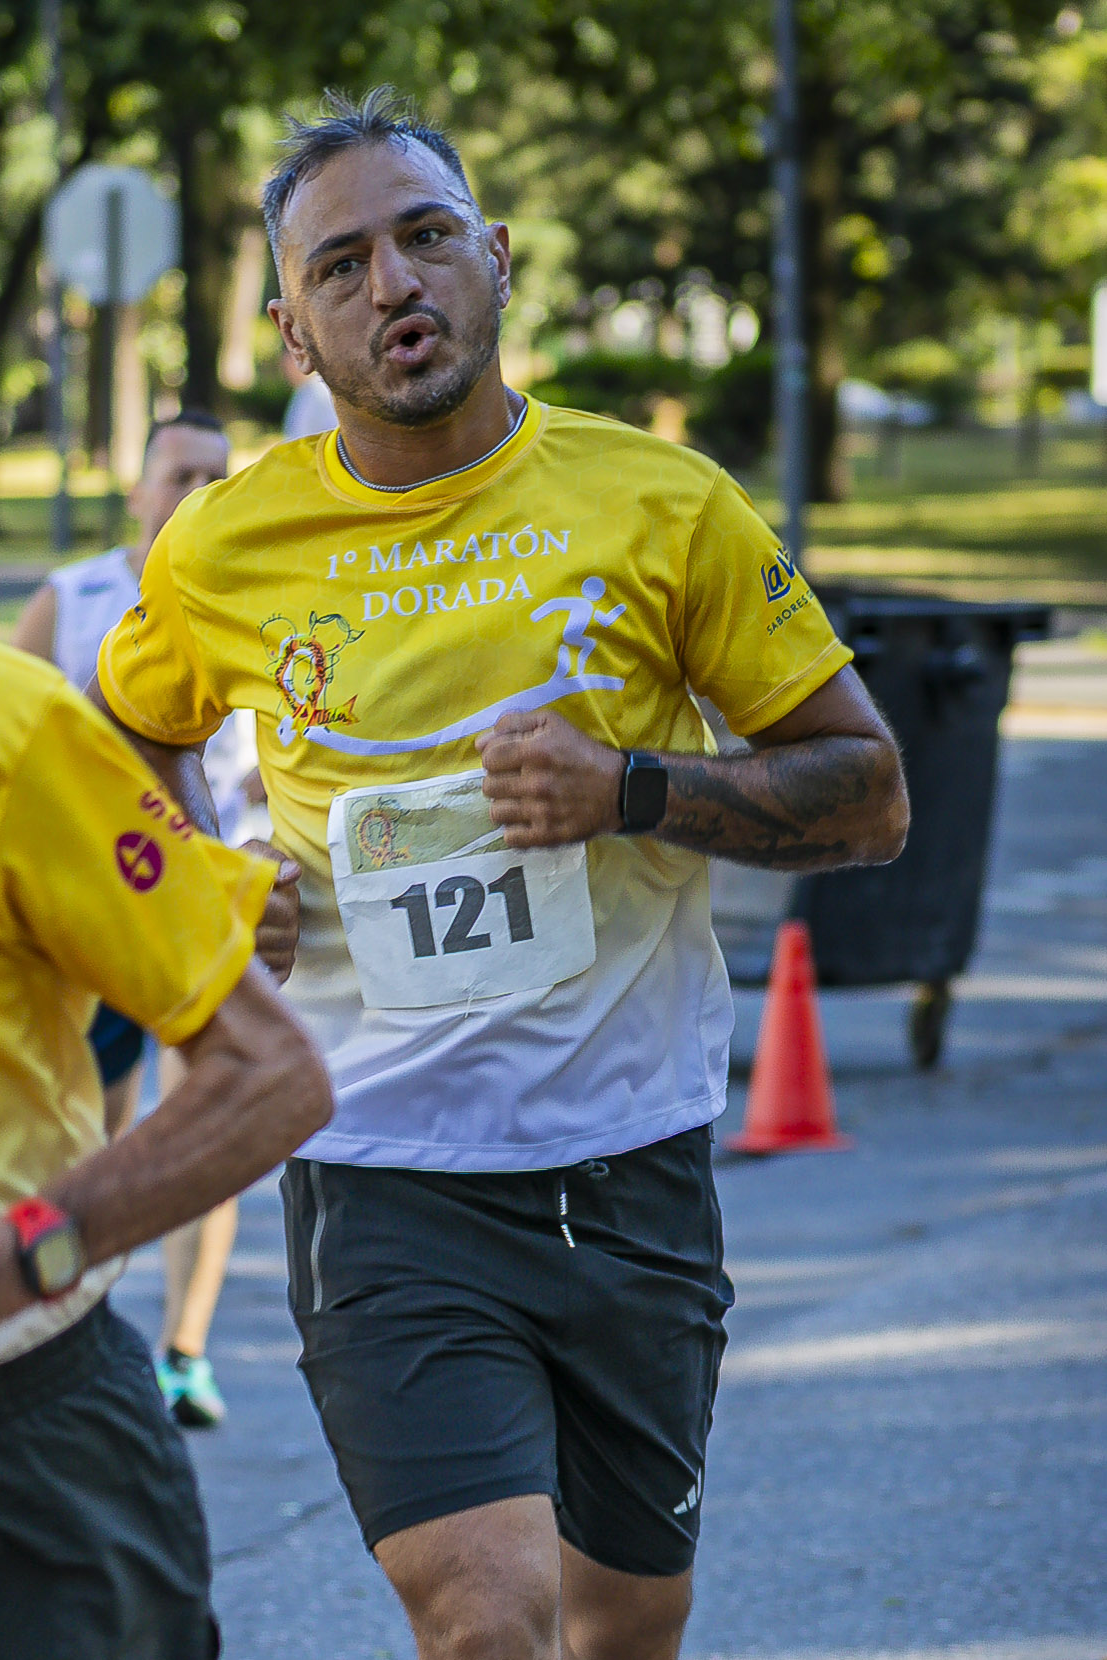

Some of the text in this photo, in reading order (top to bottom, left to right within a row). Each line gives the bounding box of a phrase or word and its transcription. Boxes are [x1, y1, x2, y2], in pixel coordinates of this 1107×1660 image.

[367, 523, 572, 575] MARATÓN
[361, 573, 534, 622] DORADA
[766, 594, 809, 636] SABORES
[390, 865, 537, 959] 121
